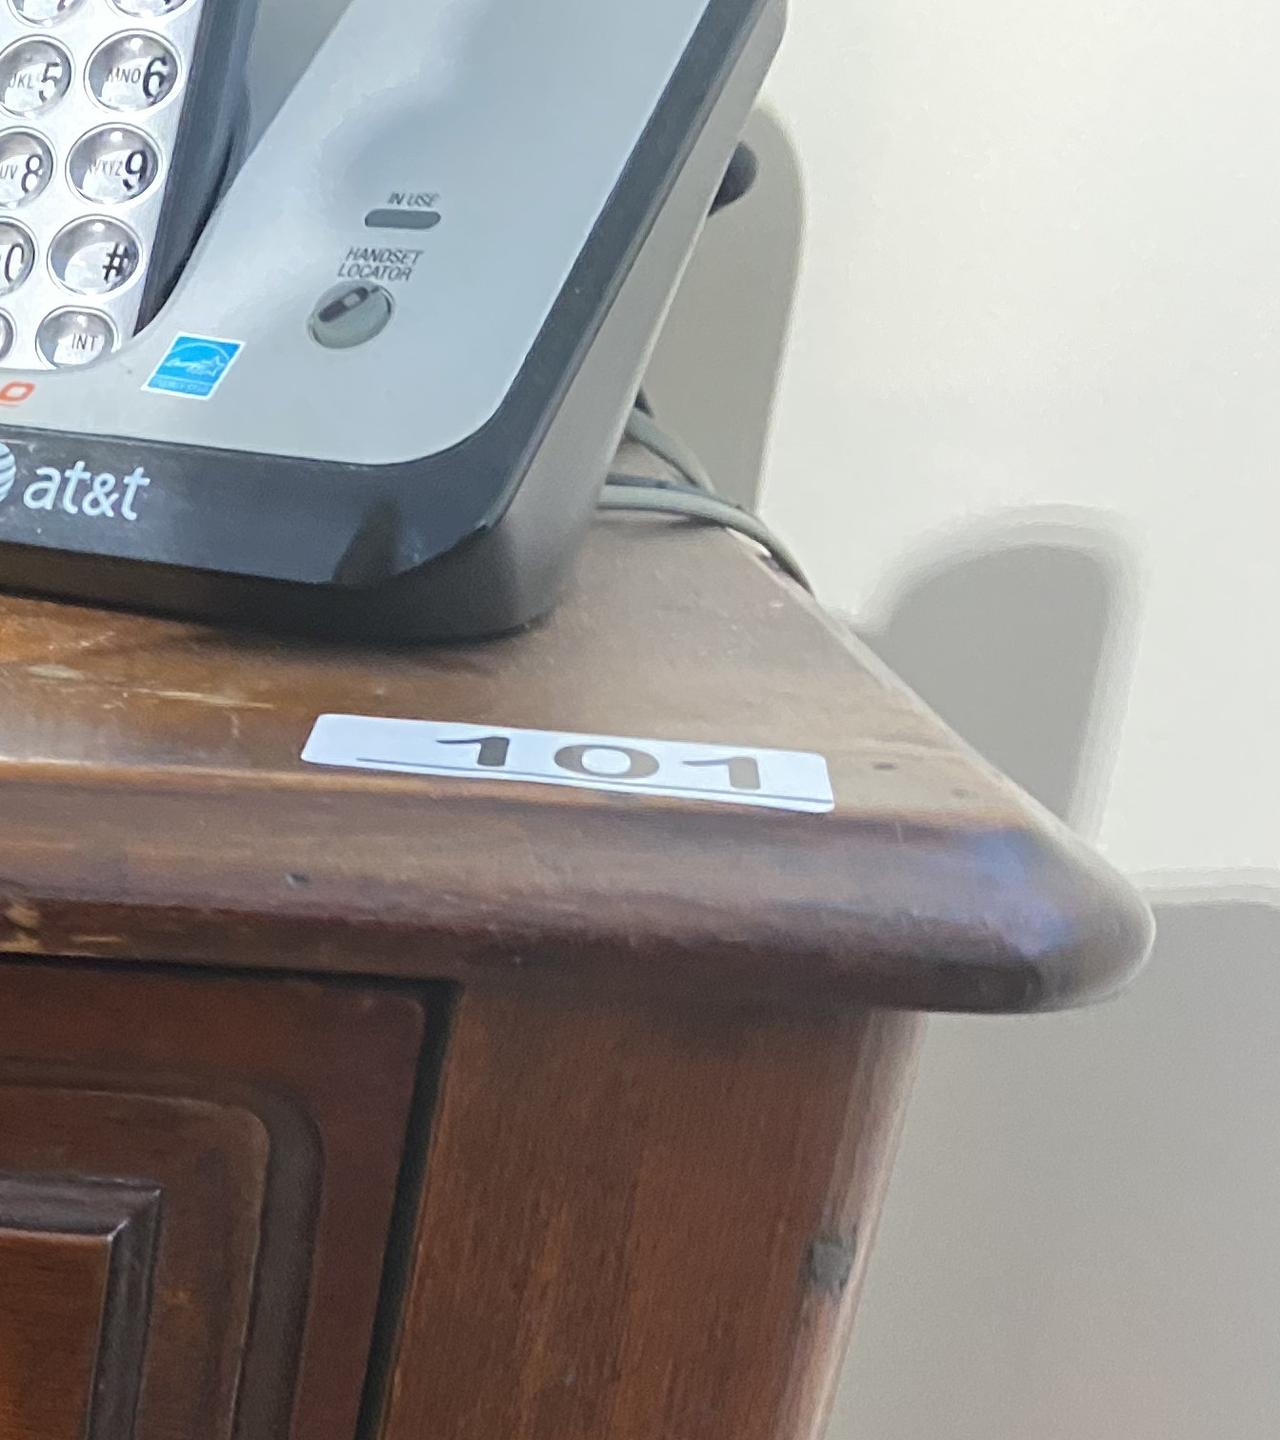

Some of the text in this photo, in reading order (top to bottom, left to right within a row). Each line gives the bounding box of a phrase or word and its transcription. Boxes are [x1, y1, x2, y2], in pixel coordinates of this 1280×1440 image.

[38, 62, 61, 102] 5
[143, 56, 170, 99] 6
[21, 154, 43, 194] 8
[122, 150, 148, 191] 9
[337, 262, 413, 282] LOCATOR
[344, 247, 424, 266] HANDSET
[22, 459, 152, 521] at&t
[434, 734, 763, 793] 101
